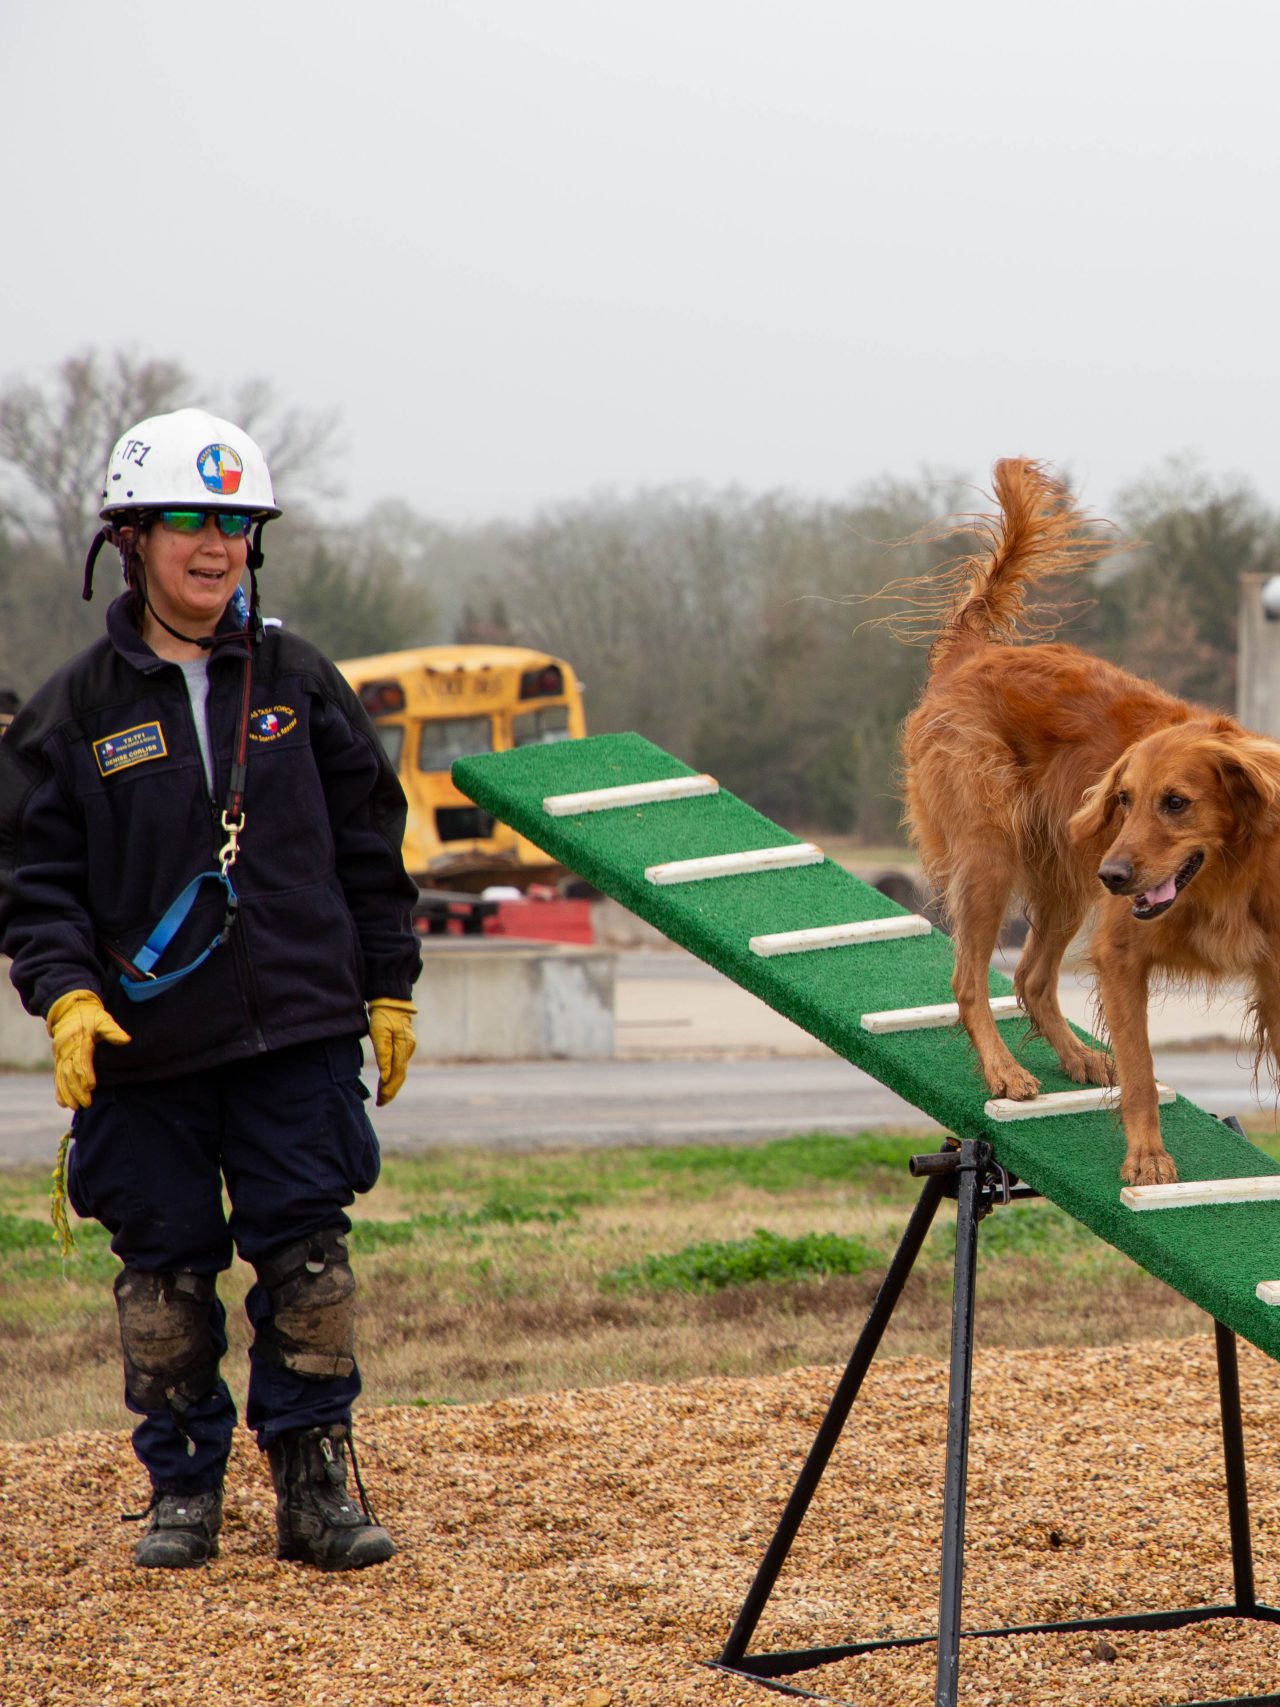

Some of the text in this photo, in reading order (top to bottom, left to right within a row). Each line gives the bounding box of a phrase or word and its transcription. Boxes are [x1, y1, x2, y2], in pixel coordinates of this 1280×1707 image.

[273, 705, 295, 716] FORCE
[105, 754, 129, 767] DENISE
[128, 744, 157, 758] CORLISS
